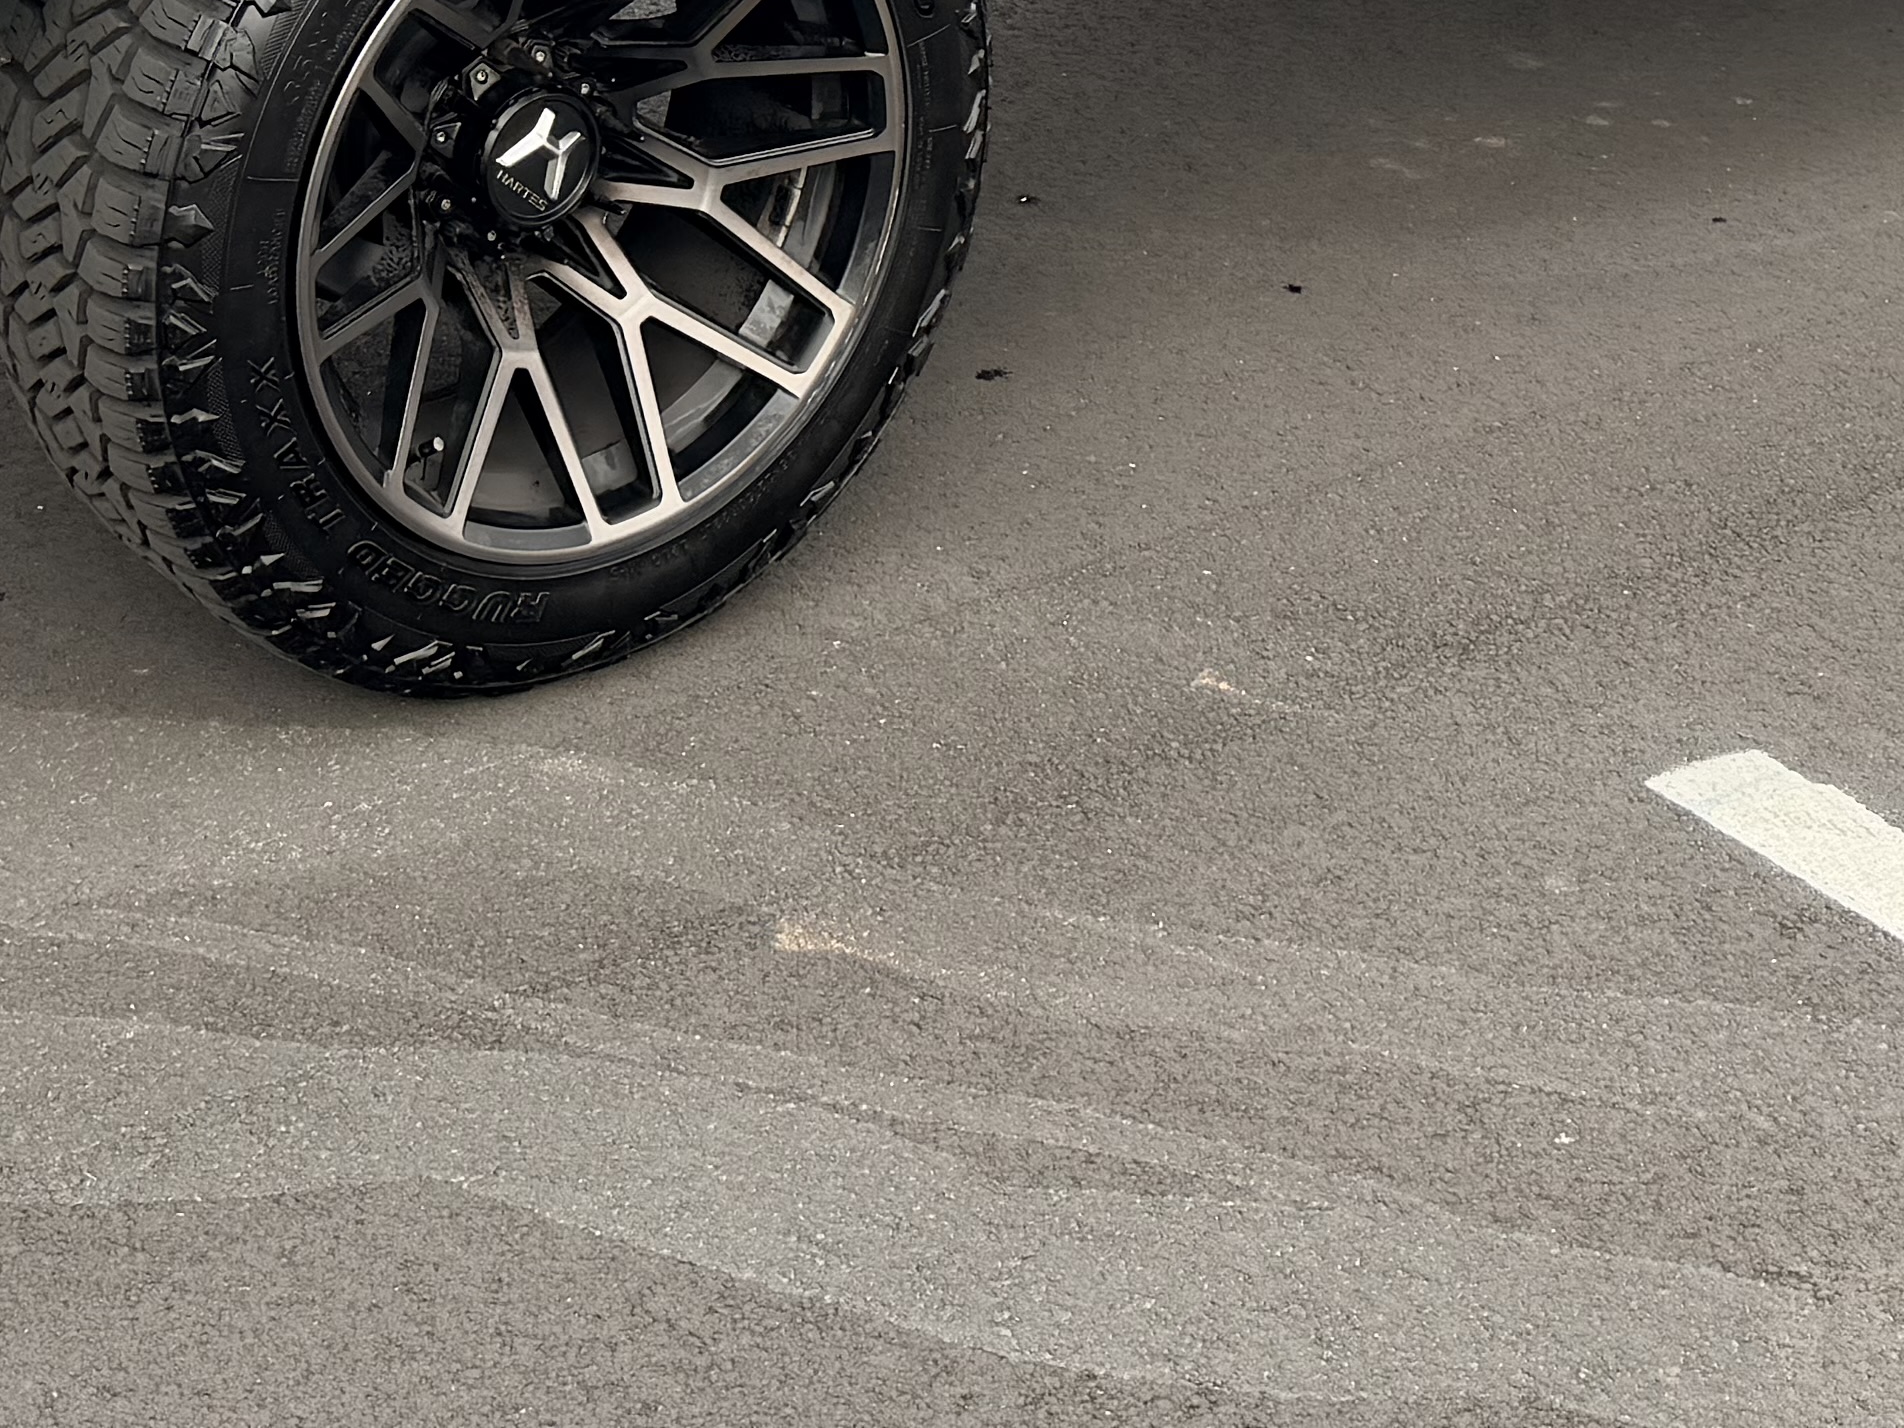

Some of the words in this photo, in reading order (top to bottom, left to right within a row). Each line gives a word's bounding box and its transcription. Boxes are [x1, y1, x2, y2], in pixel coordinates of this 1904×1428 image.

[496, 169, 549, 212] HARTES
[246, 356, 347, 538] TRAXX
[347, 539, 551, 623] RUGGED
